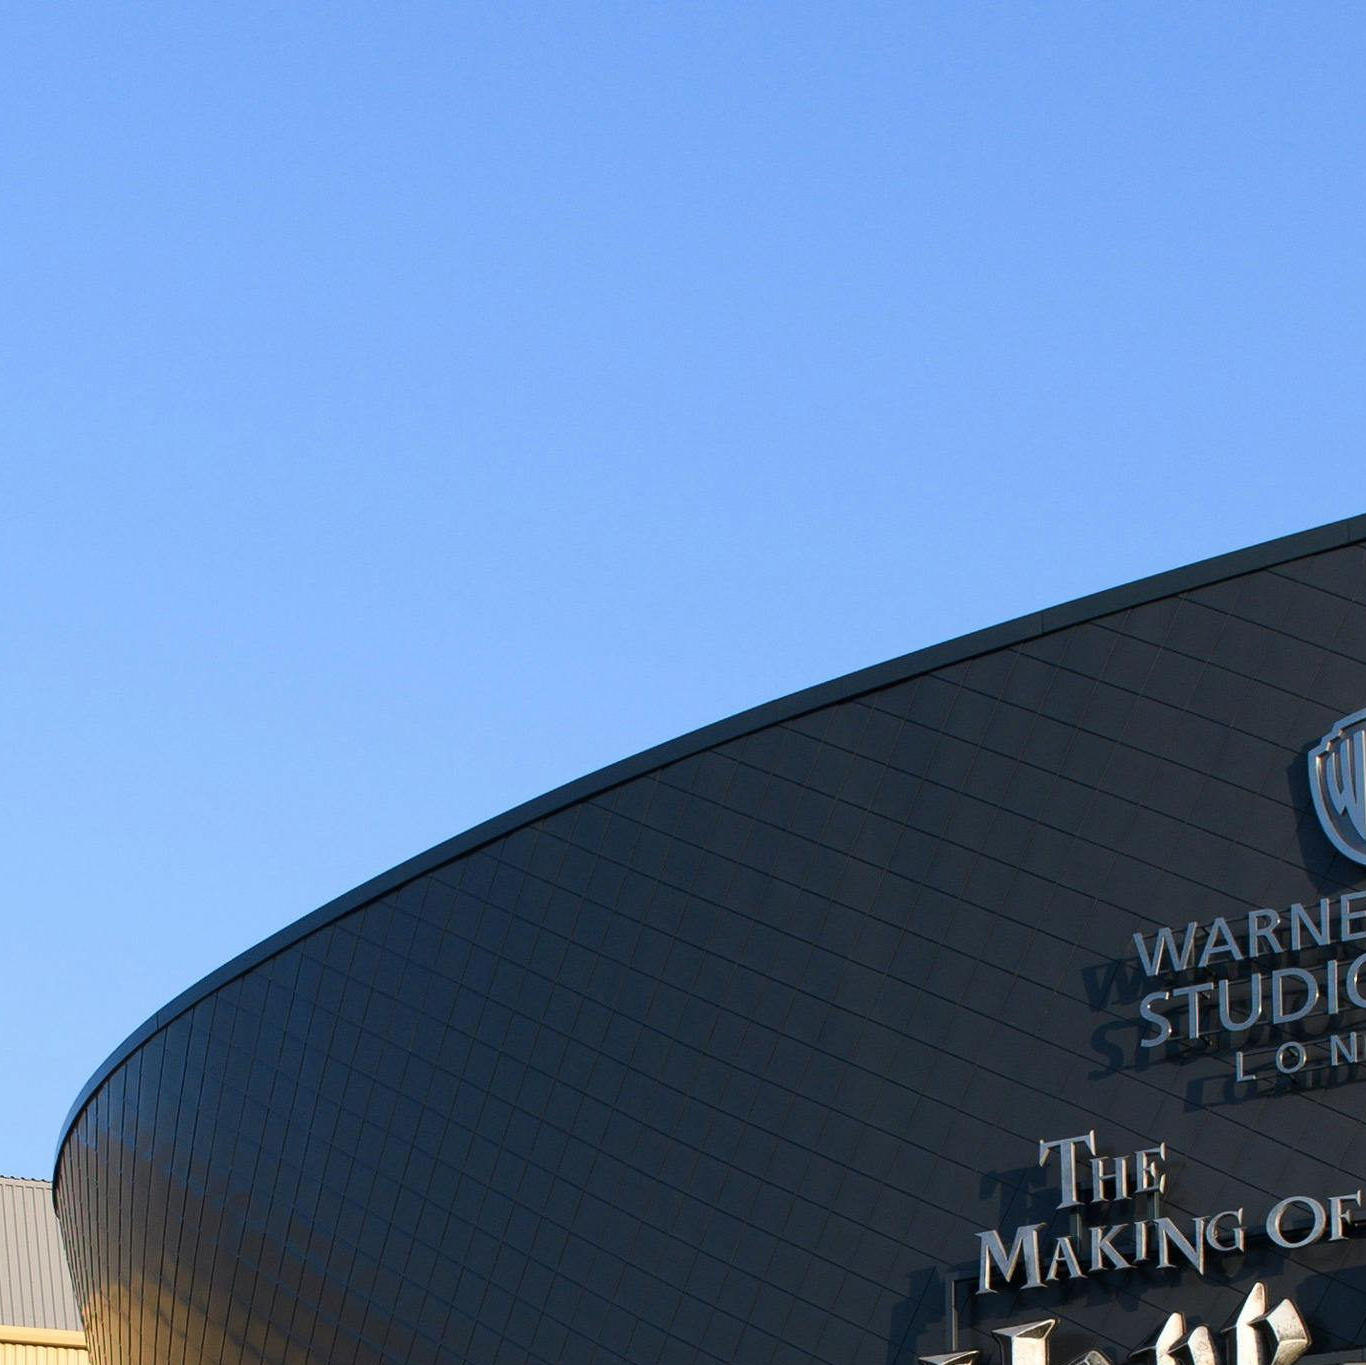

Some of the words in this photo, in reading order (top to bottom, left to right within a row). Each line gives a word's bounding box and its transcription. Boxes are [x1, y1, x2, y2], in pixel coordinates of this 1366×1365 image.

[1038, 1129, 1166, 1211] THE
[976, 1207, 1245, 1295] MAKING
[1265, 1189, 1362, 1250] OF
